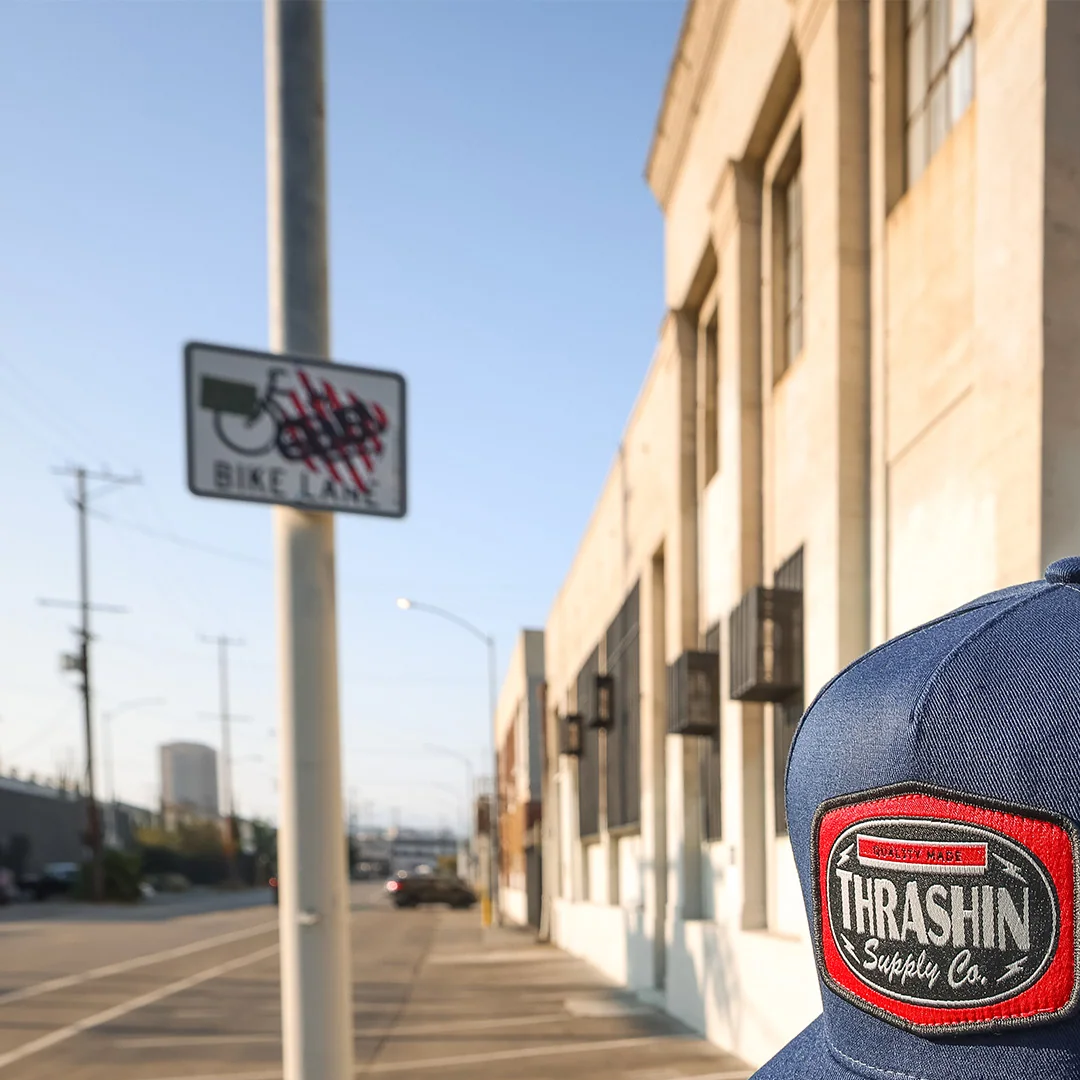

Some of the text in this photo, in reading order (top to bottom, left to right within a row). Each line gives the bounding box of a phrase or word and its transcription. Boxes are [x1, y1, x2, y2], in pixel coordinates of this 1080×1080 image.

[213, 460, 286, 495] BIKE
[873, 846, 963, 862] QUALITY MADE
[836, 869, 1031, 951] THRASHIN
[863, 938, 988, 989] Supply Co.
